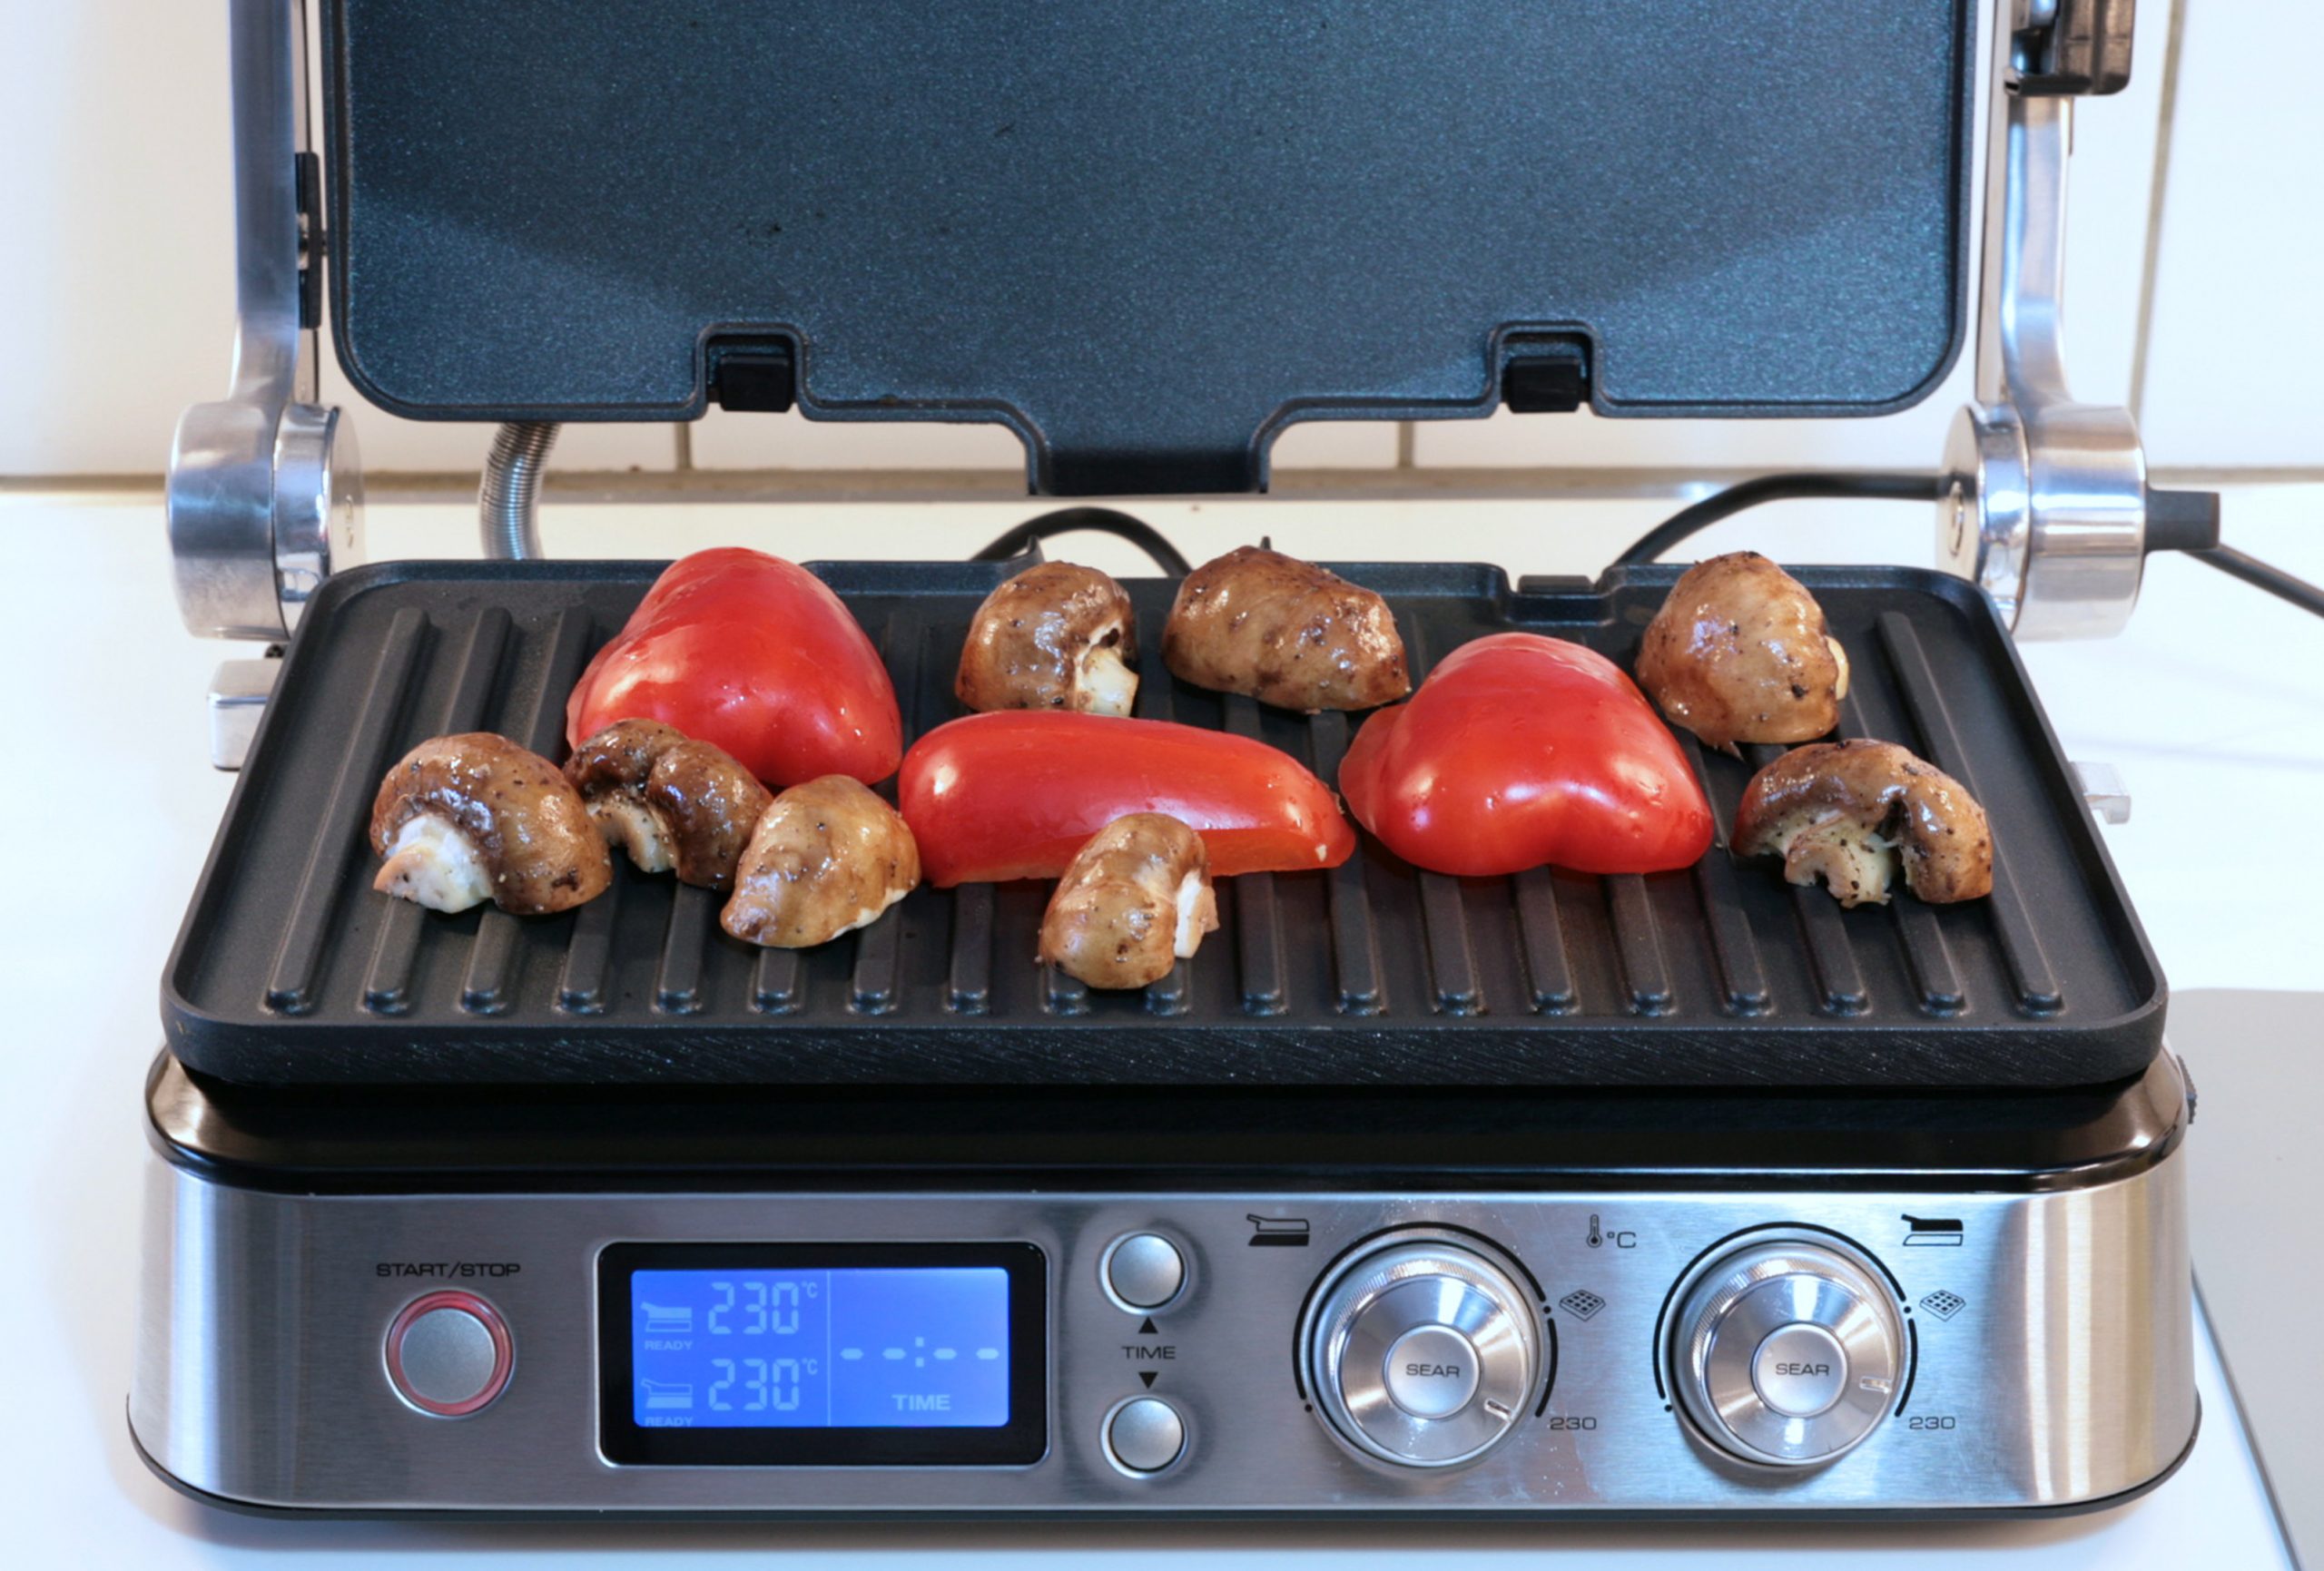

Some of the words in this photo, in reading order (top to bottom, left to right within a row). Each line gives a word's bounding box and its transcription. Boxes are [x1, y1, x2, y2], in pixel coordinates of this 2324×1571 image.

[376, 1262, 520, 1278] START/STOP
[644, 1340, 693, 1351] READY
[1122, 1346, 1176, 1360] TIME
[1406, 1364, 1460, 1377] SEAR
[1776, 1363, 1829, 1376] SEAR
[891, 1394, 951, 1411] TIME
[645, 1416, 694, 1427] READY
[1550, 1418, 1597, 1430] 230
[1909, 1417, 1955, 1429] 230
